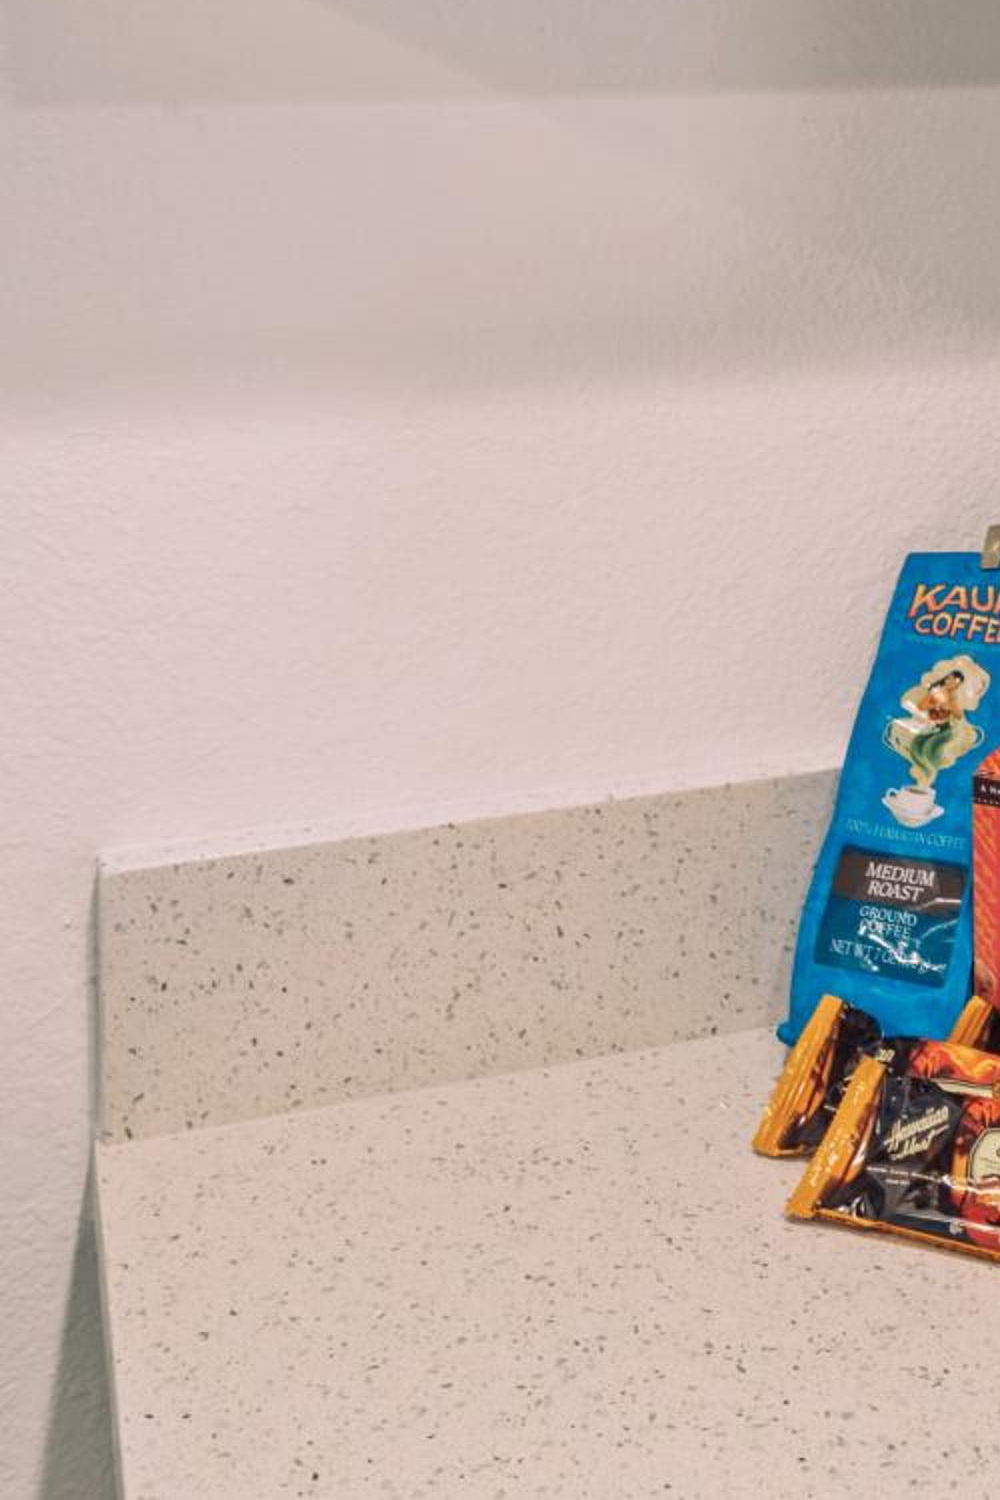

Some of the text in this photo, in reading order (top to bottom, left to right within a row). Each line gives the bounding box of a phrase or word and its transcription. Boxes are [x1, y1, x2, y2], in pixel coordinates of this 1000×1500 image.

[979, 784, 987, 794] A
[865, 861, 936, 887] MEDIUM
[867, 880, 925, 901] ROAST
[859, 905, 918, 927] GROUND
[859, 918, 911, 940] COFFEE
